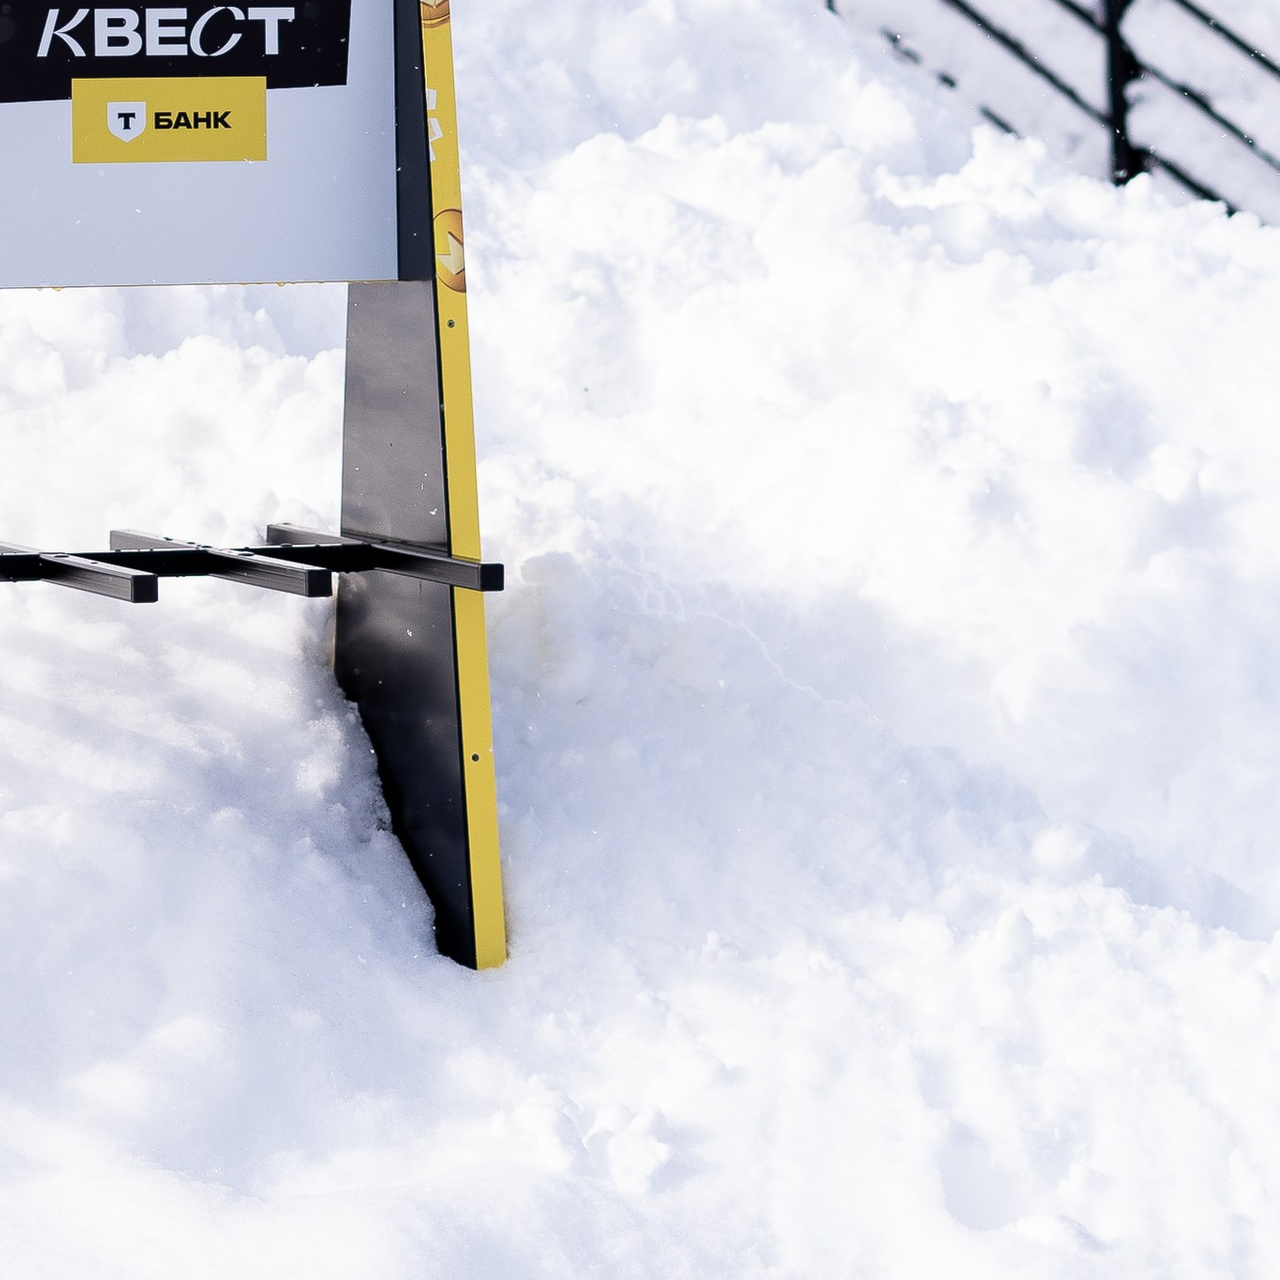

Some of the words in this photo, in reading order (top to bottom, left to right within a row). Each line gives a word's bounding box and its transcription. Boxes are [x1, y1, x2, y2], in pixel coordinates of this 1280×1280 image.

[36, 6, 295, 58] КВЕСТ
[117, 112, 136, 130] Т
[154, 111, 232, 130] БАНК
